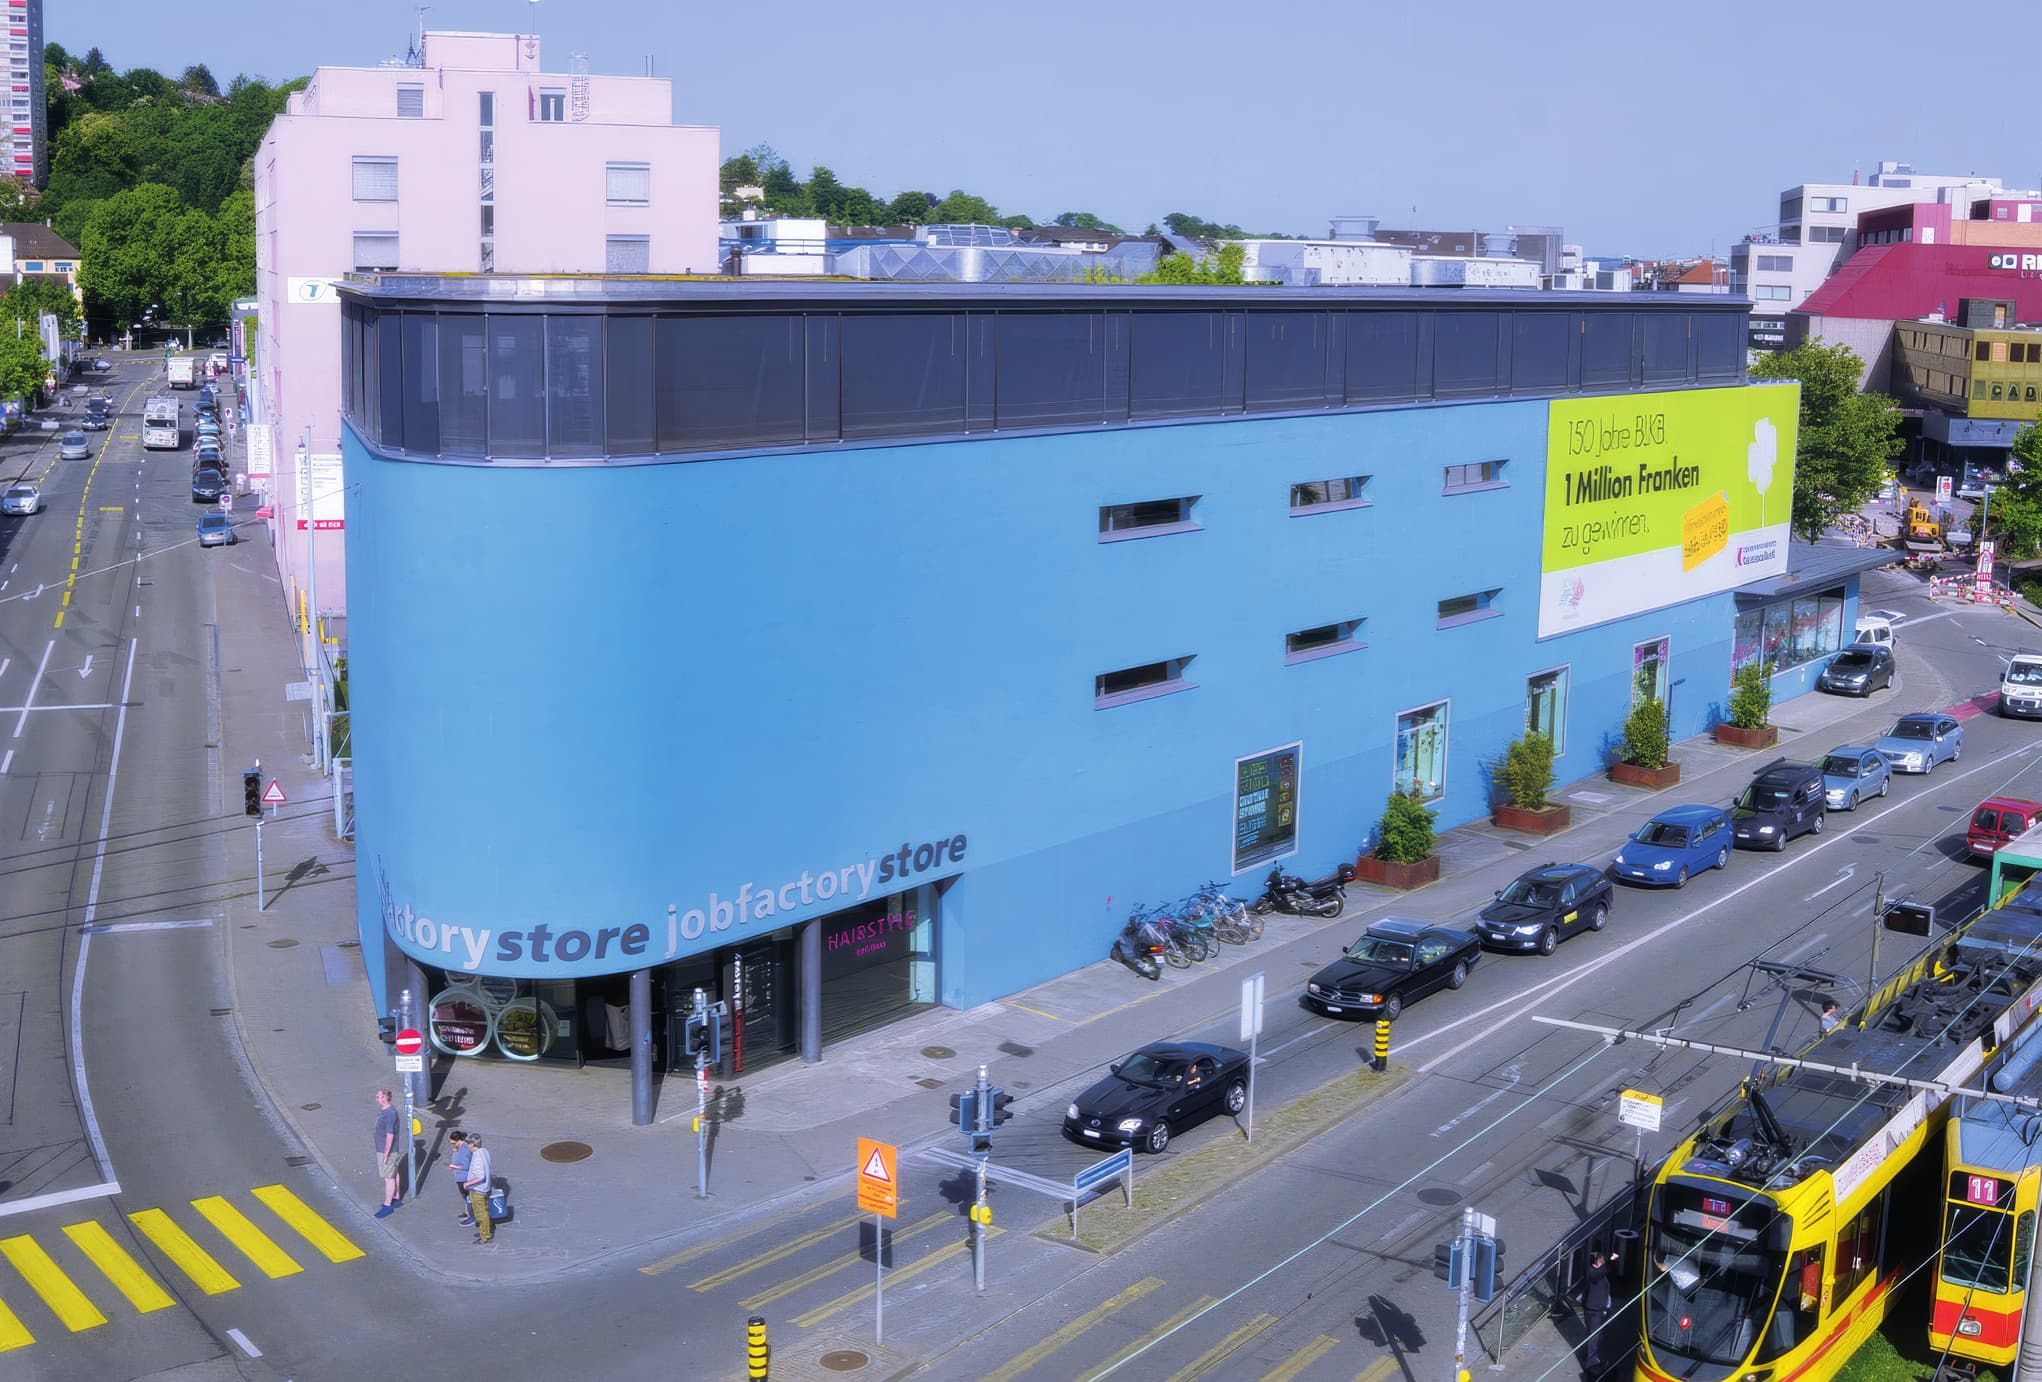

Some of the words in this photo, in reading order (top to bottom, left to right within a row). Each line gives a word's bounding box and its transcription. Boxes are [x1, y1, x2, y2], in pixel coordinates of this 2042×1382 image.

[1568, 419, 1594, 455] 150
[1595, 412, 1631, 457] Jahre
[1565, 473, 1571, 506] 1
[1575, 465, 1632, 504] Million
[1638, 455, 1699, 495] Franken
[1561, 524, 1579, 548] zu
[1971, 1178, 1994, 1201] 11
